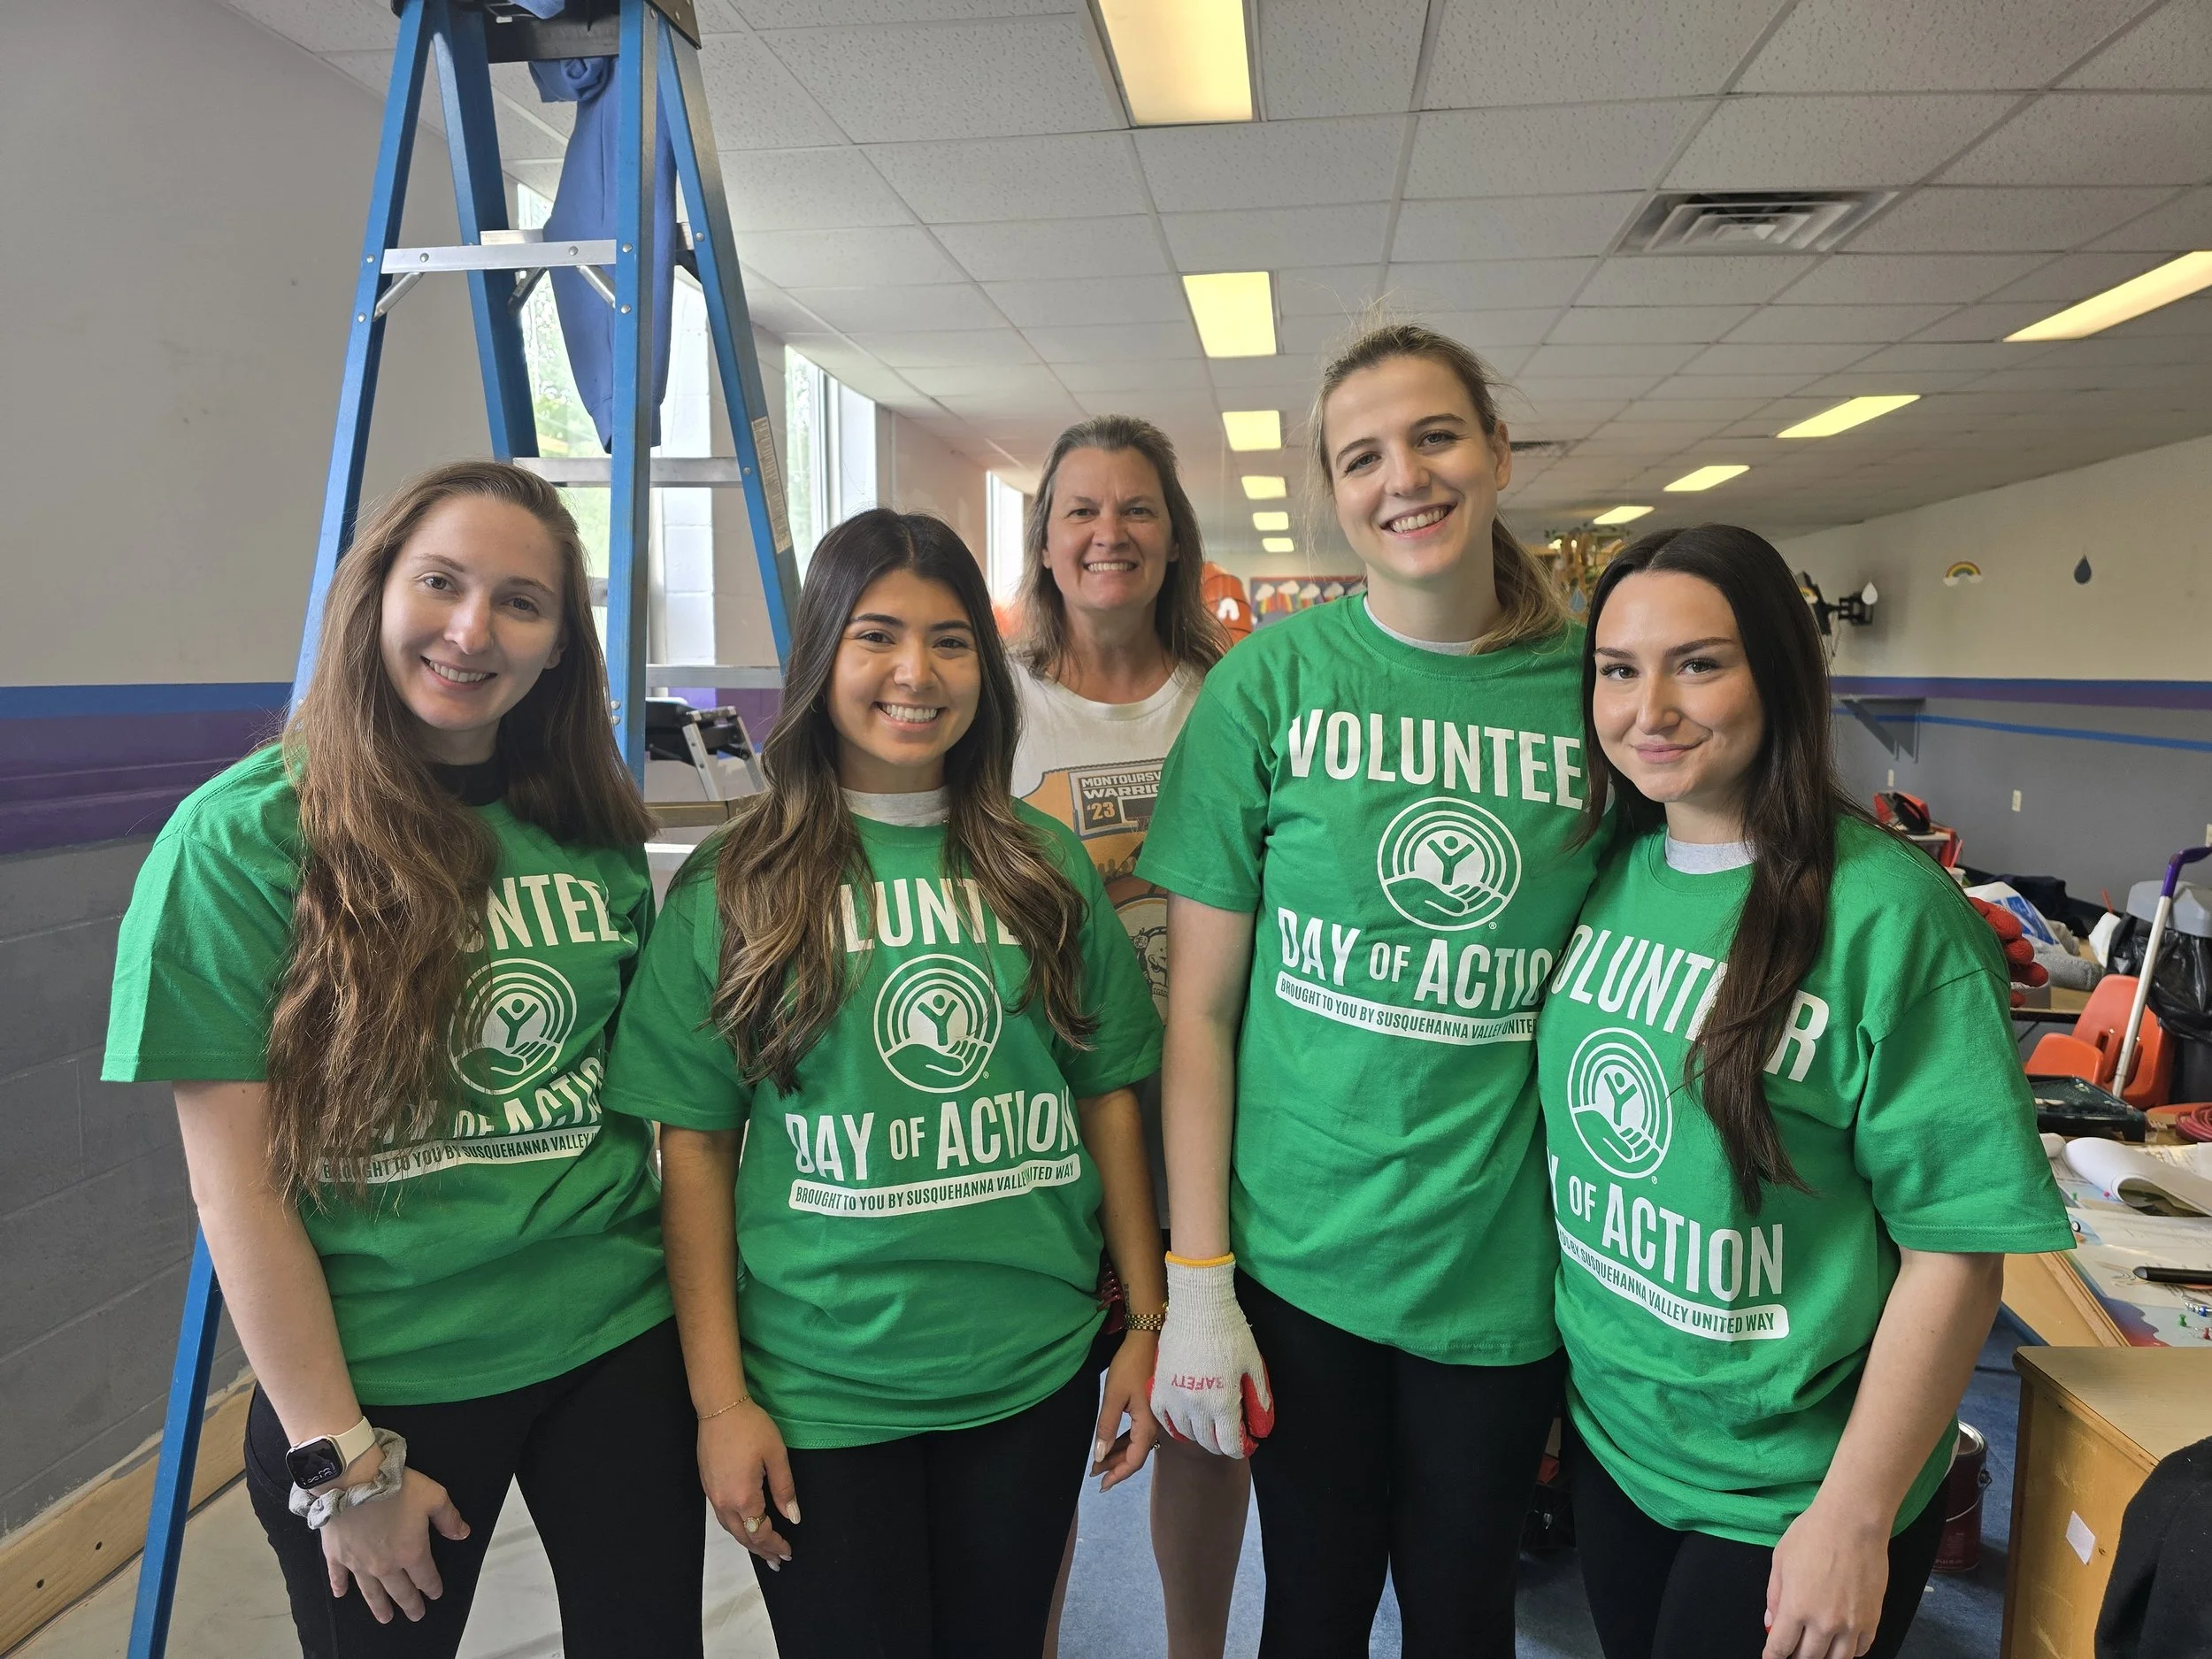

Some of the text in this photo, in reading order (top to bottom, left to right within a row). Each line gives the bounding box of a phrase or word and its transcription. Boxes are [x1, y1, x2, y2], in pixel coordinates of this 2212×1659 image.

[1080, 771, 1162, 787] MONTOURSV
[1288, 709, 1583, 810] VOLUNTEE
[1278, 907, 1554, 1011] DAY OF ACTIO
[1280, 978, 1321, 1007] BROUGHT
[1323, 995, 1333, 1011] TO
[1336, 999, 1358, 1018] YOU
[1360, 1006, 1375, 1023] BY
[1377, 1010, 1468, 1039] SUSQUEHANNA
[1471, 1023, 1503, 1039] VALLEY
[503, 1056, 603, 1134] ACTIO
[785, 1086, 1079, 1181] DAY OF ACTION
[395, 1155, 411, 1171] TO
[412, 1146, 442, 1168] YOU
[445, 1145, 462, 1161] BY
[461, 1138, 550, 1160] SUSQUEHANNA
[550, 1133, 589, 1151] VALLEY
[795, 1187, 842, 1210] BROUGHT
[843, 1194, 856, 1210] TO
[859, 1194, 884, 1210] YOU
[888, 1192, 903, 1209] BY
[907, 1178, 994, 1206] SUSQUEHANNA
[1056, 1161, 1074, 1179] WAY
[1569, 1175, 1597, 1223] OF
[1601, 1182, 1784, 1302] ACTION
[1580, 1248, 1647, 1303] SUSQUEHANNA
[1648, 1289, 1689, 1324] VALLEY
[1692, 1310, 1743, 1334] UNITED
[1746, 1312, 1775, 1333] WAY
[1171, 1373, 1225, 1392] SAFETY
